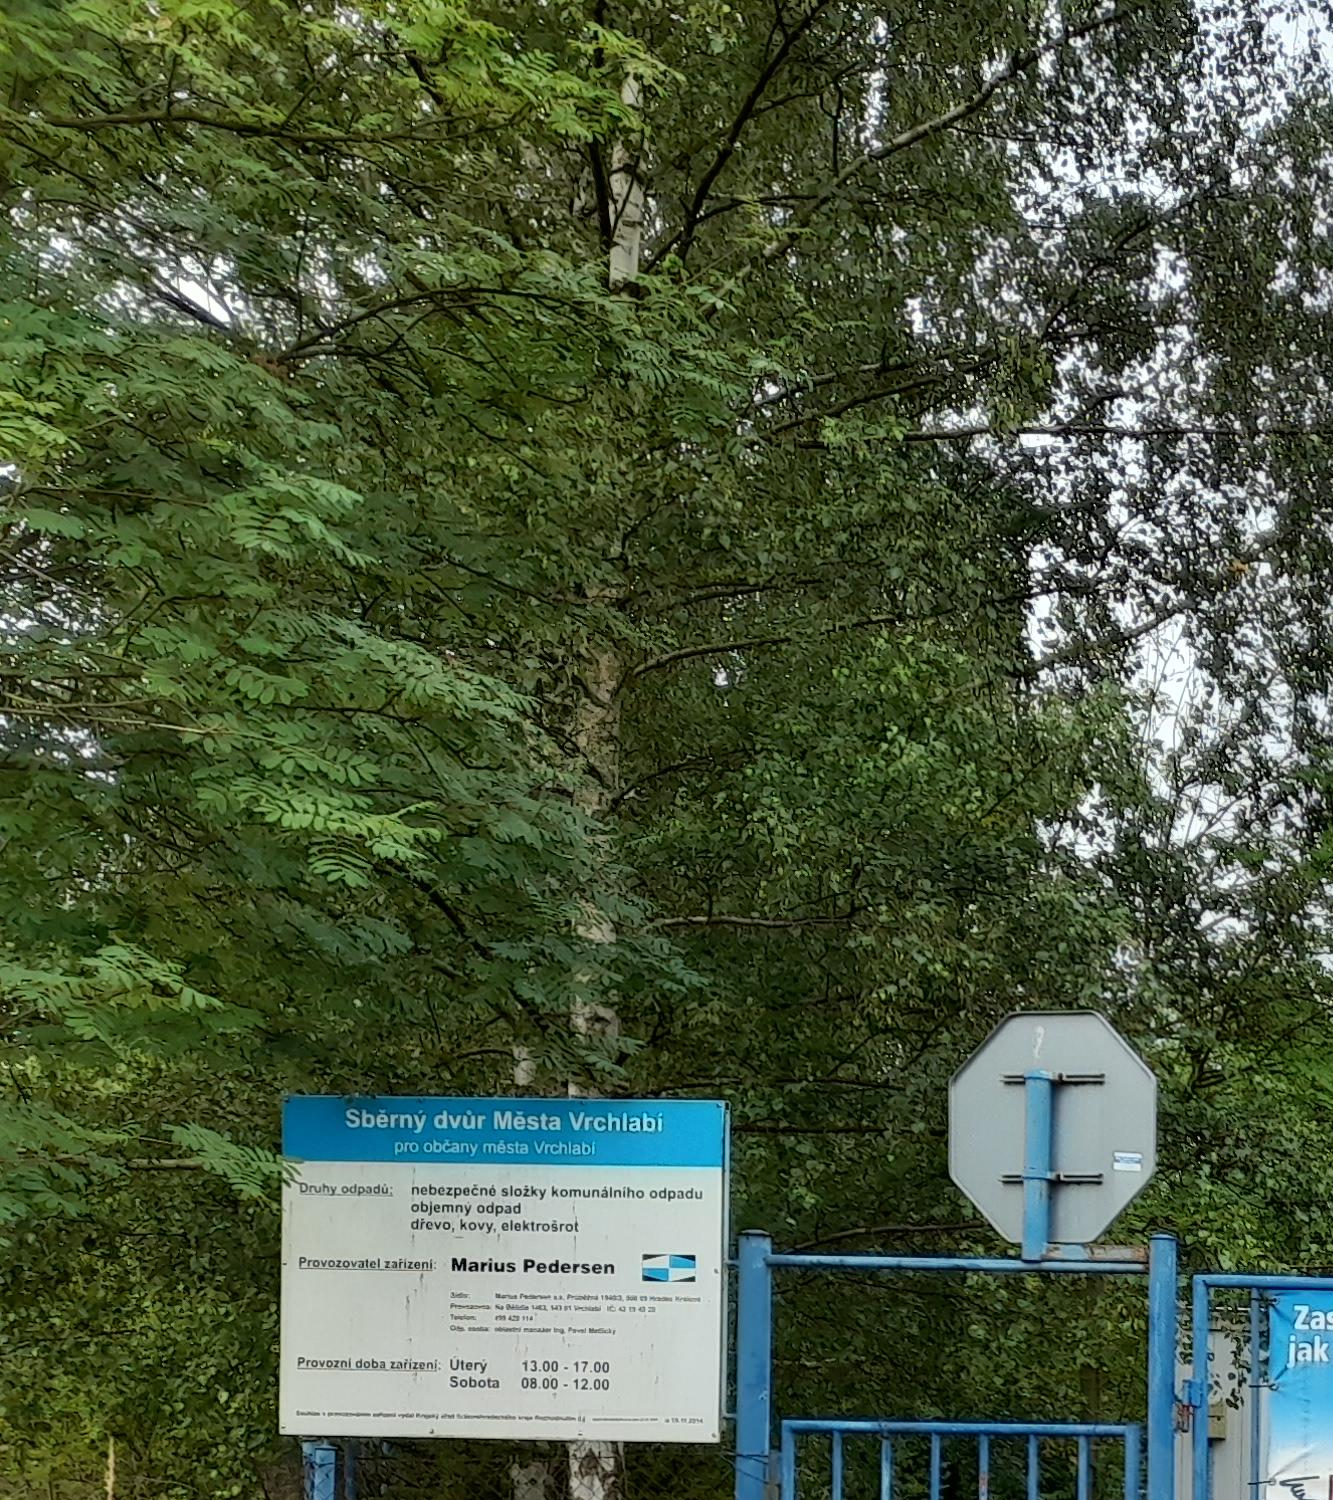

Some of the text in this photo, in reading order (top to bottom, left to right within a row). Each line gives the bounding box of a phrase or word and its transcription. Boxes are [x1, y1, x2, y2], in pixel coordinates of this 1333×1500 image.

[345, 1108, 663, 1133] Sběrný dvůr Města Vrchlabí
[394, 1139, 596, 1157] pro občany města Vrchlabí
[299, 1182, 393, 1196] Druhy odpadů:
[411, 1184, 703, 1202] nebezpečné složky komunálního odpadu
[411, 1202, 521, 1217] objemný odpad
[411, 1219, 579, 1234] dřevo, kovy, elektrošrot
[299, 1257, 438, 1270] Provozovatel zařízení:
[451, 1258, 615, 1274] Marius Pedersen
[1288, 1335, 1329, 1368] jak
[297, 1357, 351, 1369] Provozní
[355, 1358, 386, 1370] doba
[449, 1356, 488, 1374] Úterý
[522, 1360, 559, 1372] 13.00
[573, 1361, 610, 1373] 17.00
[449, 1376, 500, 1389] Sobota
[521, 1377, 559, 1390] 08.00
[573, 1378, 610, 1391] 12.00
